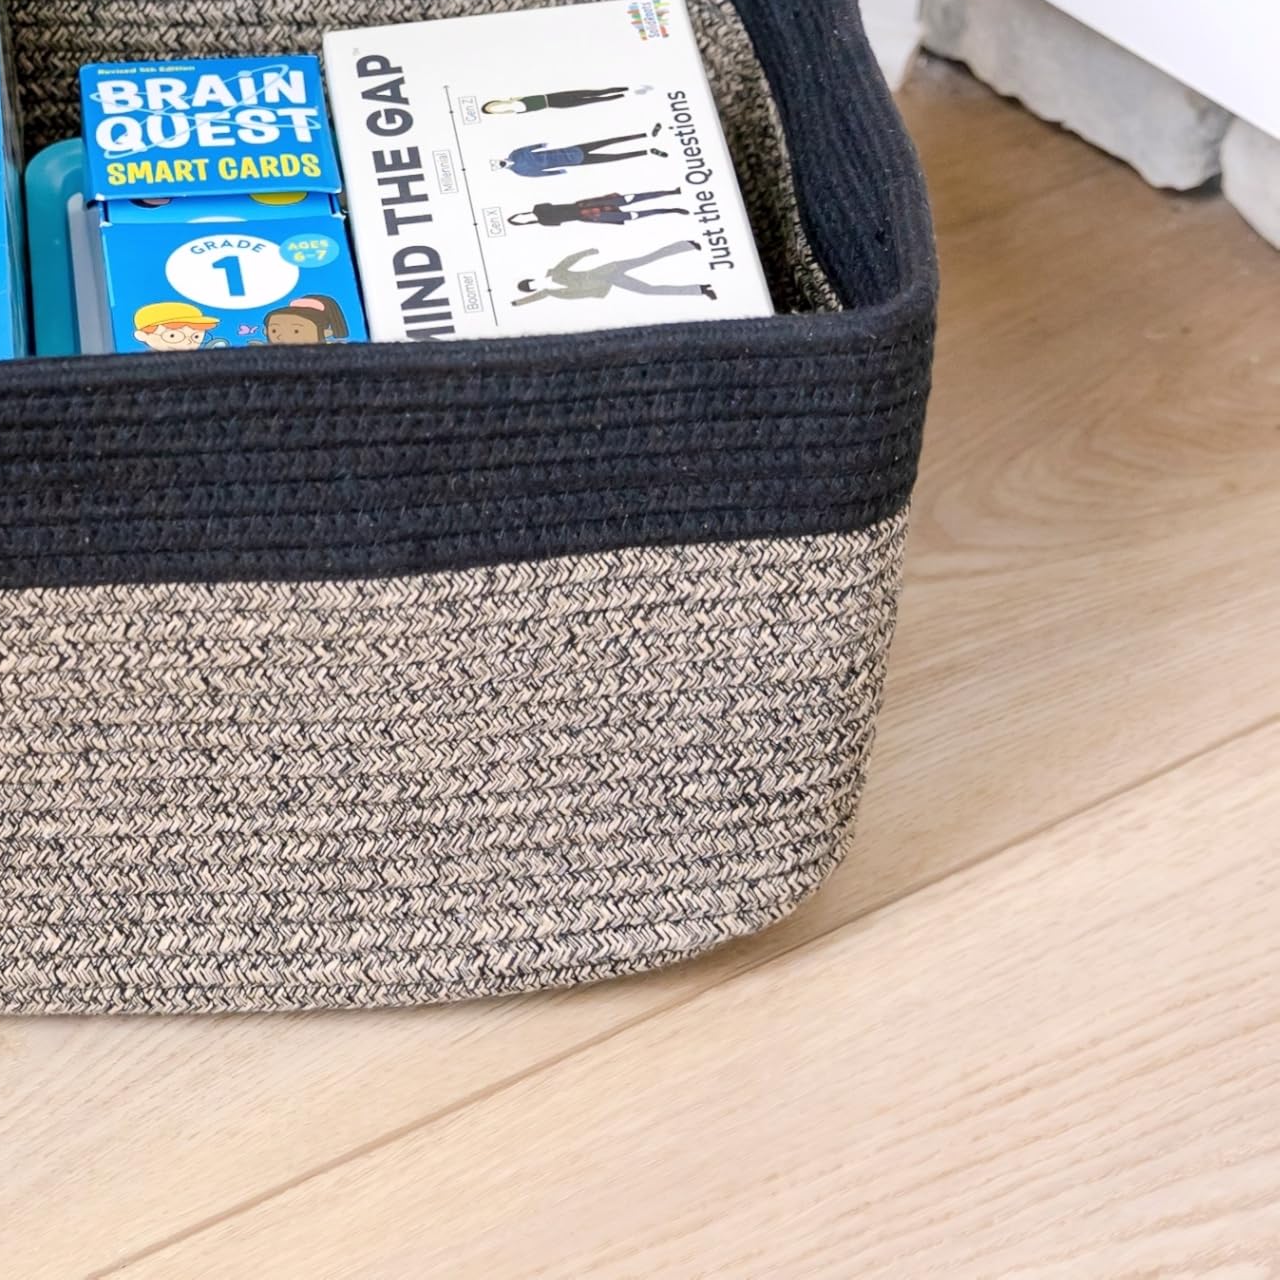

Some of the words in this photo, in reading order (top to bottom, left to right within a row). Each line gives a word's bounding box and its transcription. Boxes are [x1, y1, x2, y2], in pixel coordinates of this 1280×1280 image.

[355, 54, 414, 137] GAP
[95, 107, 318, 152] QUEST
[668, 90, 713, 185] Questions
[106, 158, 209, 186] SMART
[218, 153, 322, 180] CARDS
[372, 146, 433, 237] THE
[693, 190, 721, 224] the
[190, 239, 266, 255] GRADE
[288, 239, 329, 251] AGES
[702, 227, 734, 271] Just
[212, 255, 245, 296] 1
[463, 274, 479, 311] Boomer
